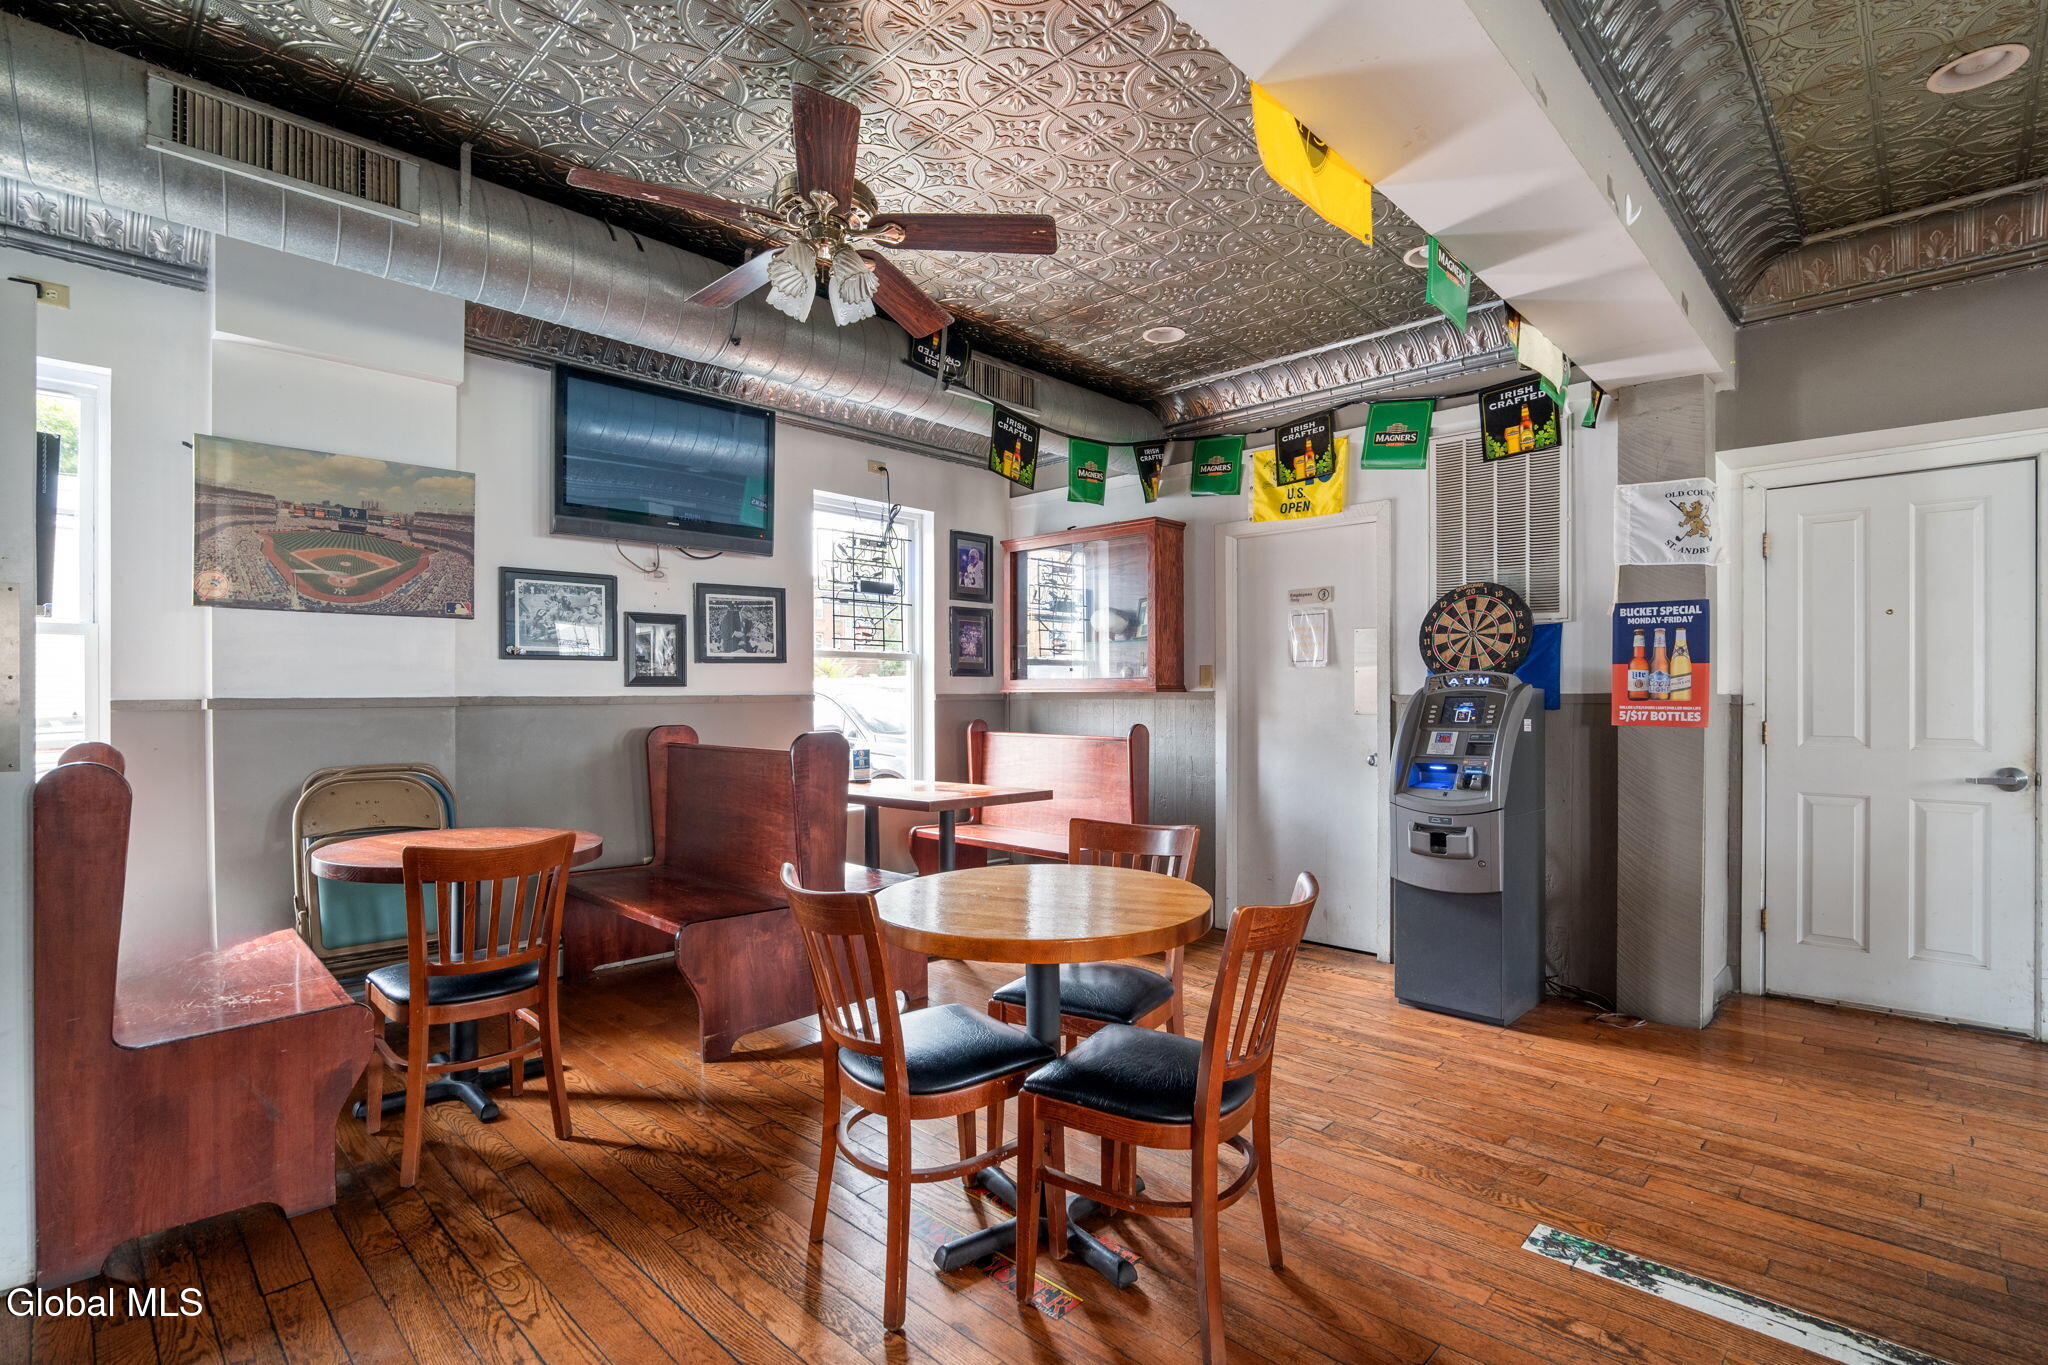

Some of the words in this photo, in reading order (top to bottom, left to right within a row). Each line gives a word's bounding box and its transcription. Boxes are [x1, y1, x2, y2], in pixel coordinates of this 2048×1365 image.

[1438, 247, 1466, 286] MAGNERS
[1500, 385, 1533, 400] IRISH
[1488, 390, 1546, 410] CRAFTED
[1006, 416, 1028, 432] IRISH
[1290, 421, 1316, 434] IRISH
[997, 421, 1033, 442] CRAFTED
[1282, 425, 1326, 442] CRAFTED
[1375, 433, 1417, 442] MAGNERS
[1200, 463, 1232, 473] MAGNERS
[1078, 469, 1104, 481] MAGNERS
[1287, 487, 1306, 500] U.S.
[1664, 490, 1685, 499] OLD
[1280, 500, 1311, 514] OPEN
[1664, 539, 1677, 551] ST.
[1619, 607, 1658, 617] BUCKET
[1659, 605, 1702, 616] SPECIAL
[1627, 616, 1694, 625] MONDAY-FRIDAY
[1448, 677, 1489, 686] ATM
[1619, 709, 1649, 723] 5/$17
[1650, 711, 1701, 722] BOTTLES
